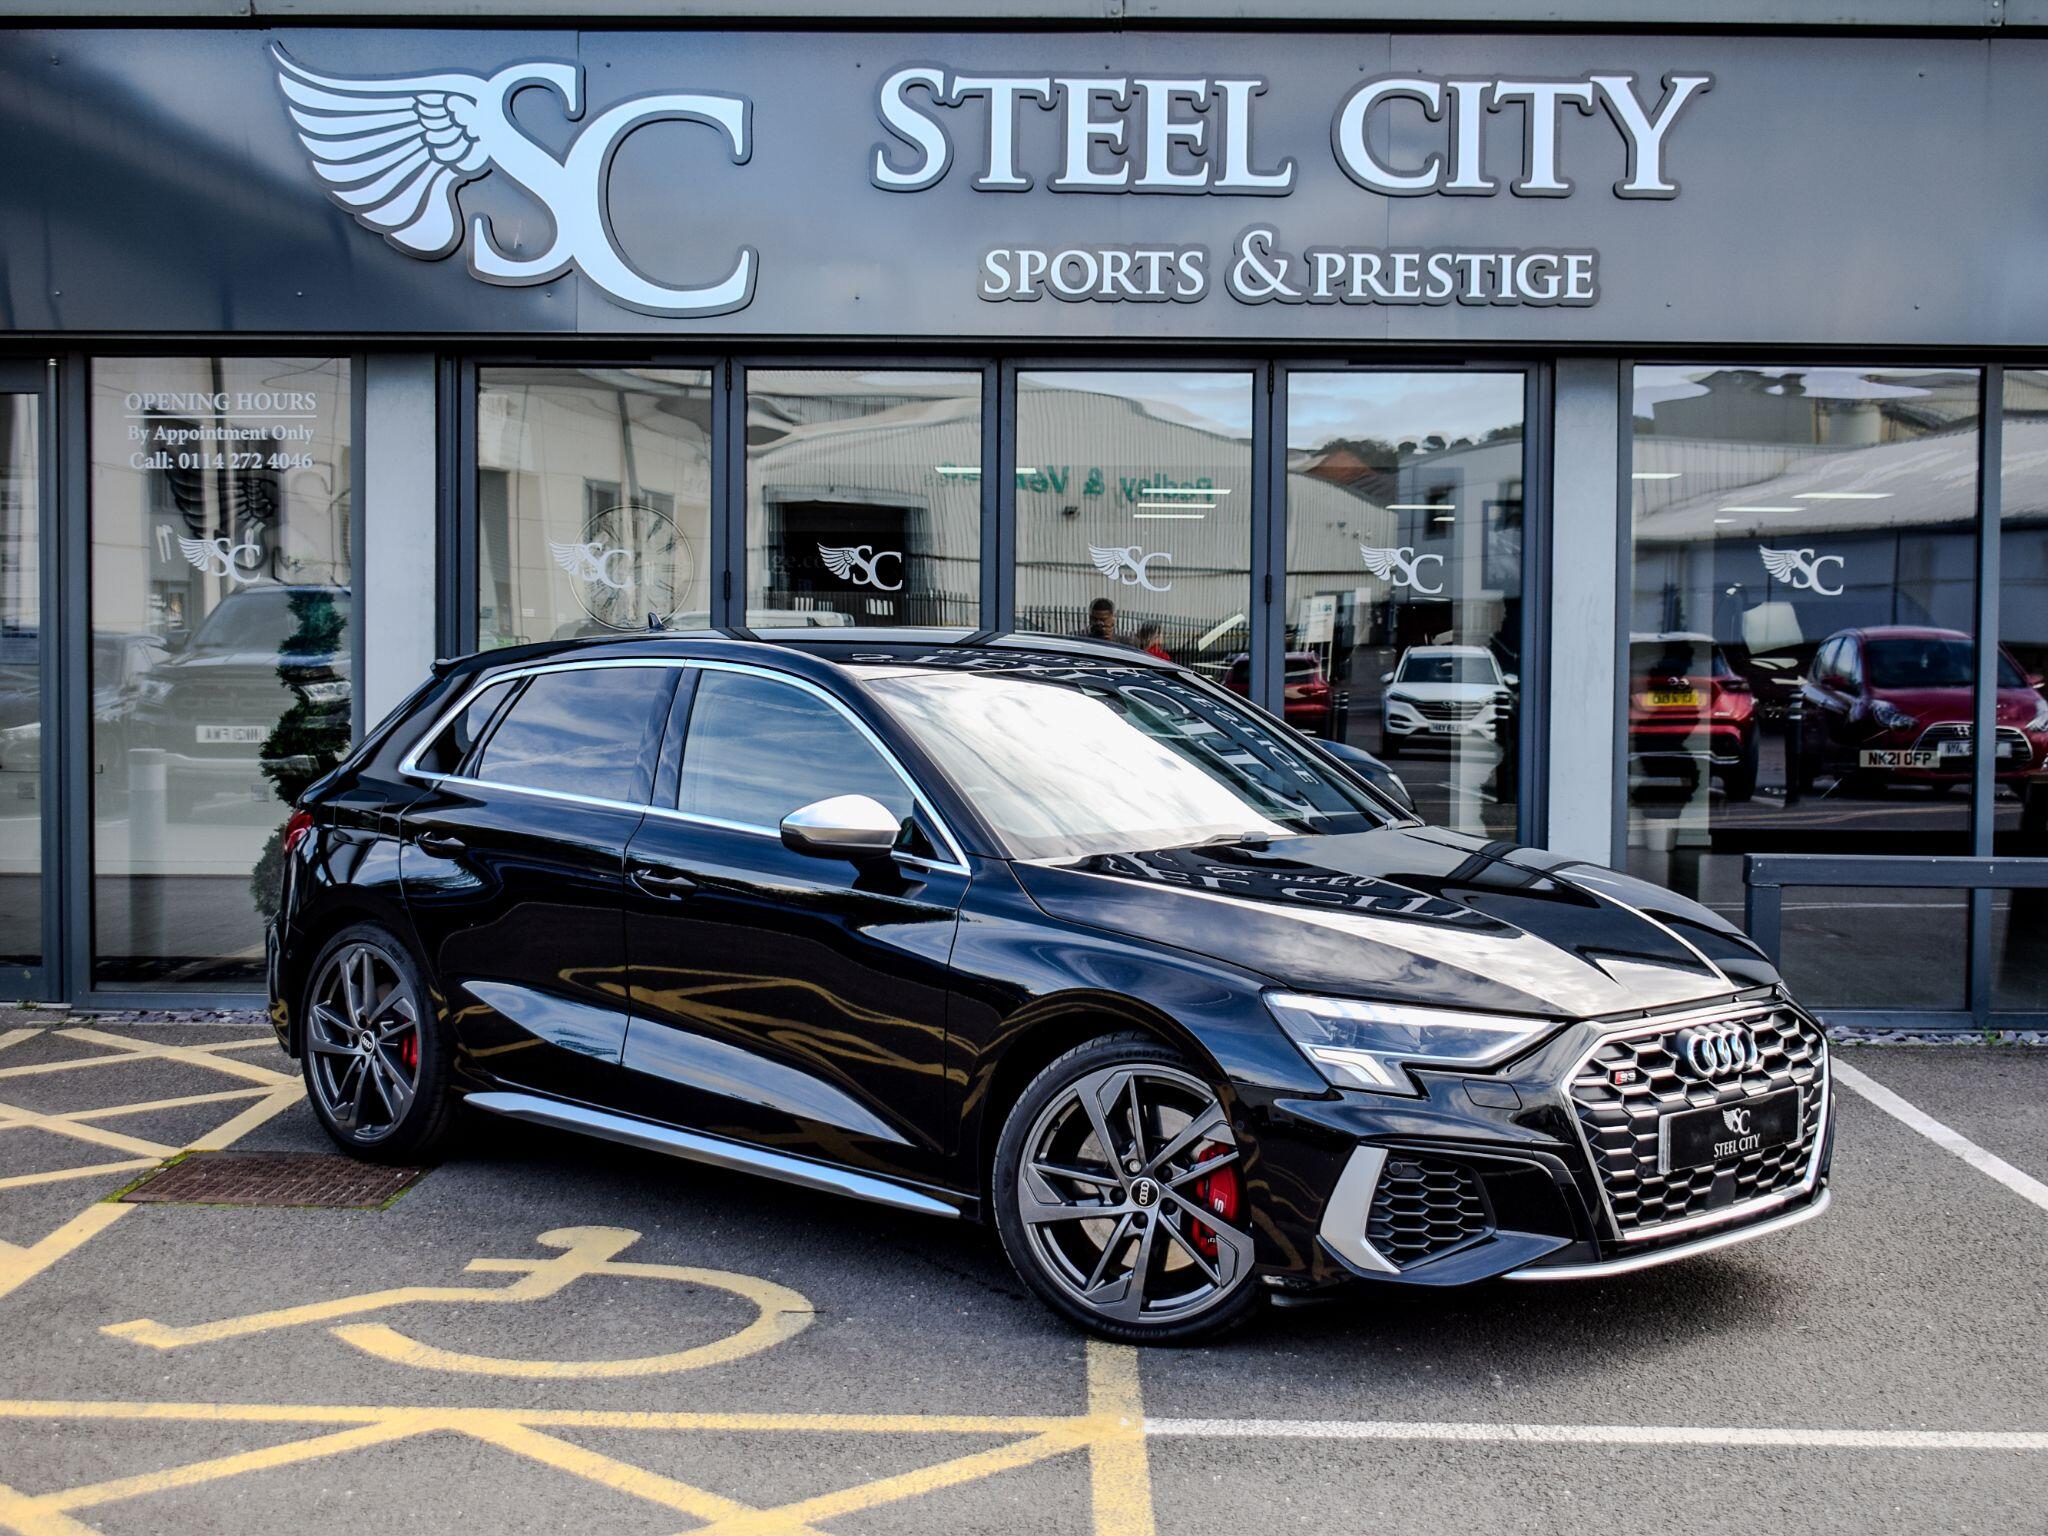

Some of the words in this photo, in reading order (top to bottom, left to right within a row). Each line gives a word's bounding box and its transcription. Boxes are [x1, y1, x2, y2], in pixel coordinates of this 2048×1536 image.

[874, 67, 1295, 192] STEEL
[1337, 75, 1711, 194] CITY
[470, 60, 756, 313] SC
[983, 248, 1205, 297] SPORTS
[1232, 229, 1302, 298] &
[1313, 251, 1594, 299] PRESTIGE
[125, 392, 230, 411] OPENING
[237, 392, 317, 411] HOURS
[127, 426, 150, 445] By
[153, 425, 268, 446] Appointment
[271, 424, 314, 445] Only
[129, 451, 174, 470] Call:
[178, 452, 224, 470] 0114
[229, 452, 263, 470] 272
[266, 452, 313, 470] 4046
[1868, 751, 1901, 766] NK21
[1713, 1140, 1738, 1158] STEEL
[1739, 1134, 1761, 1152] CITY
